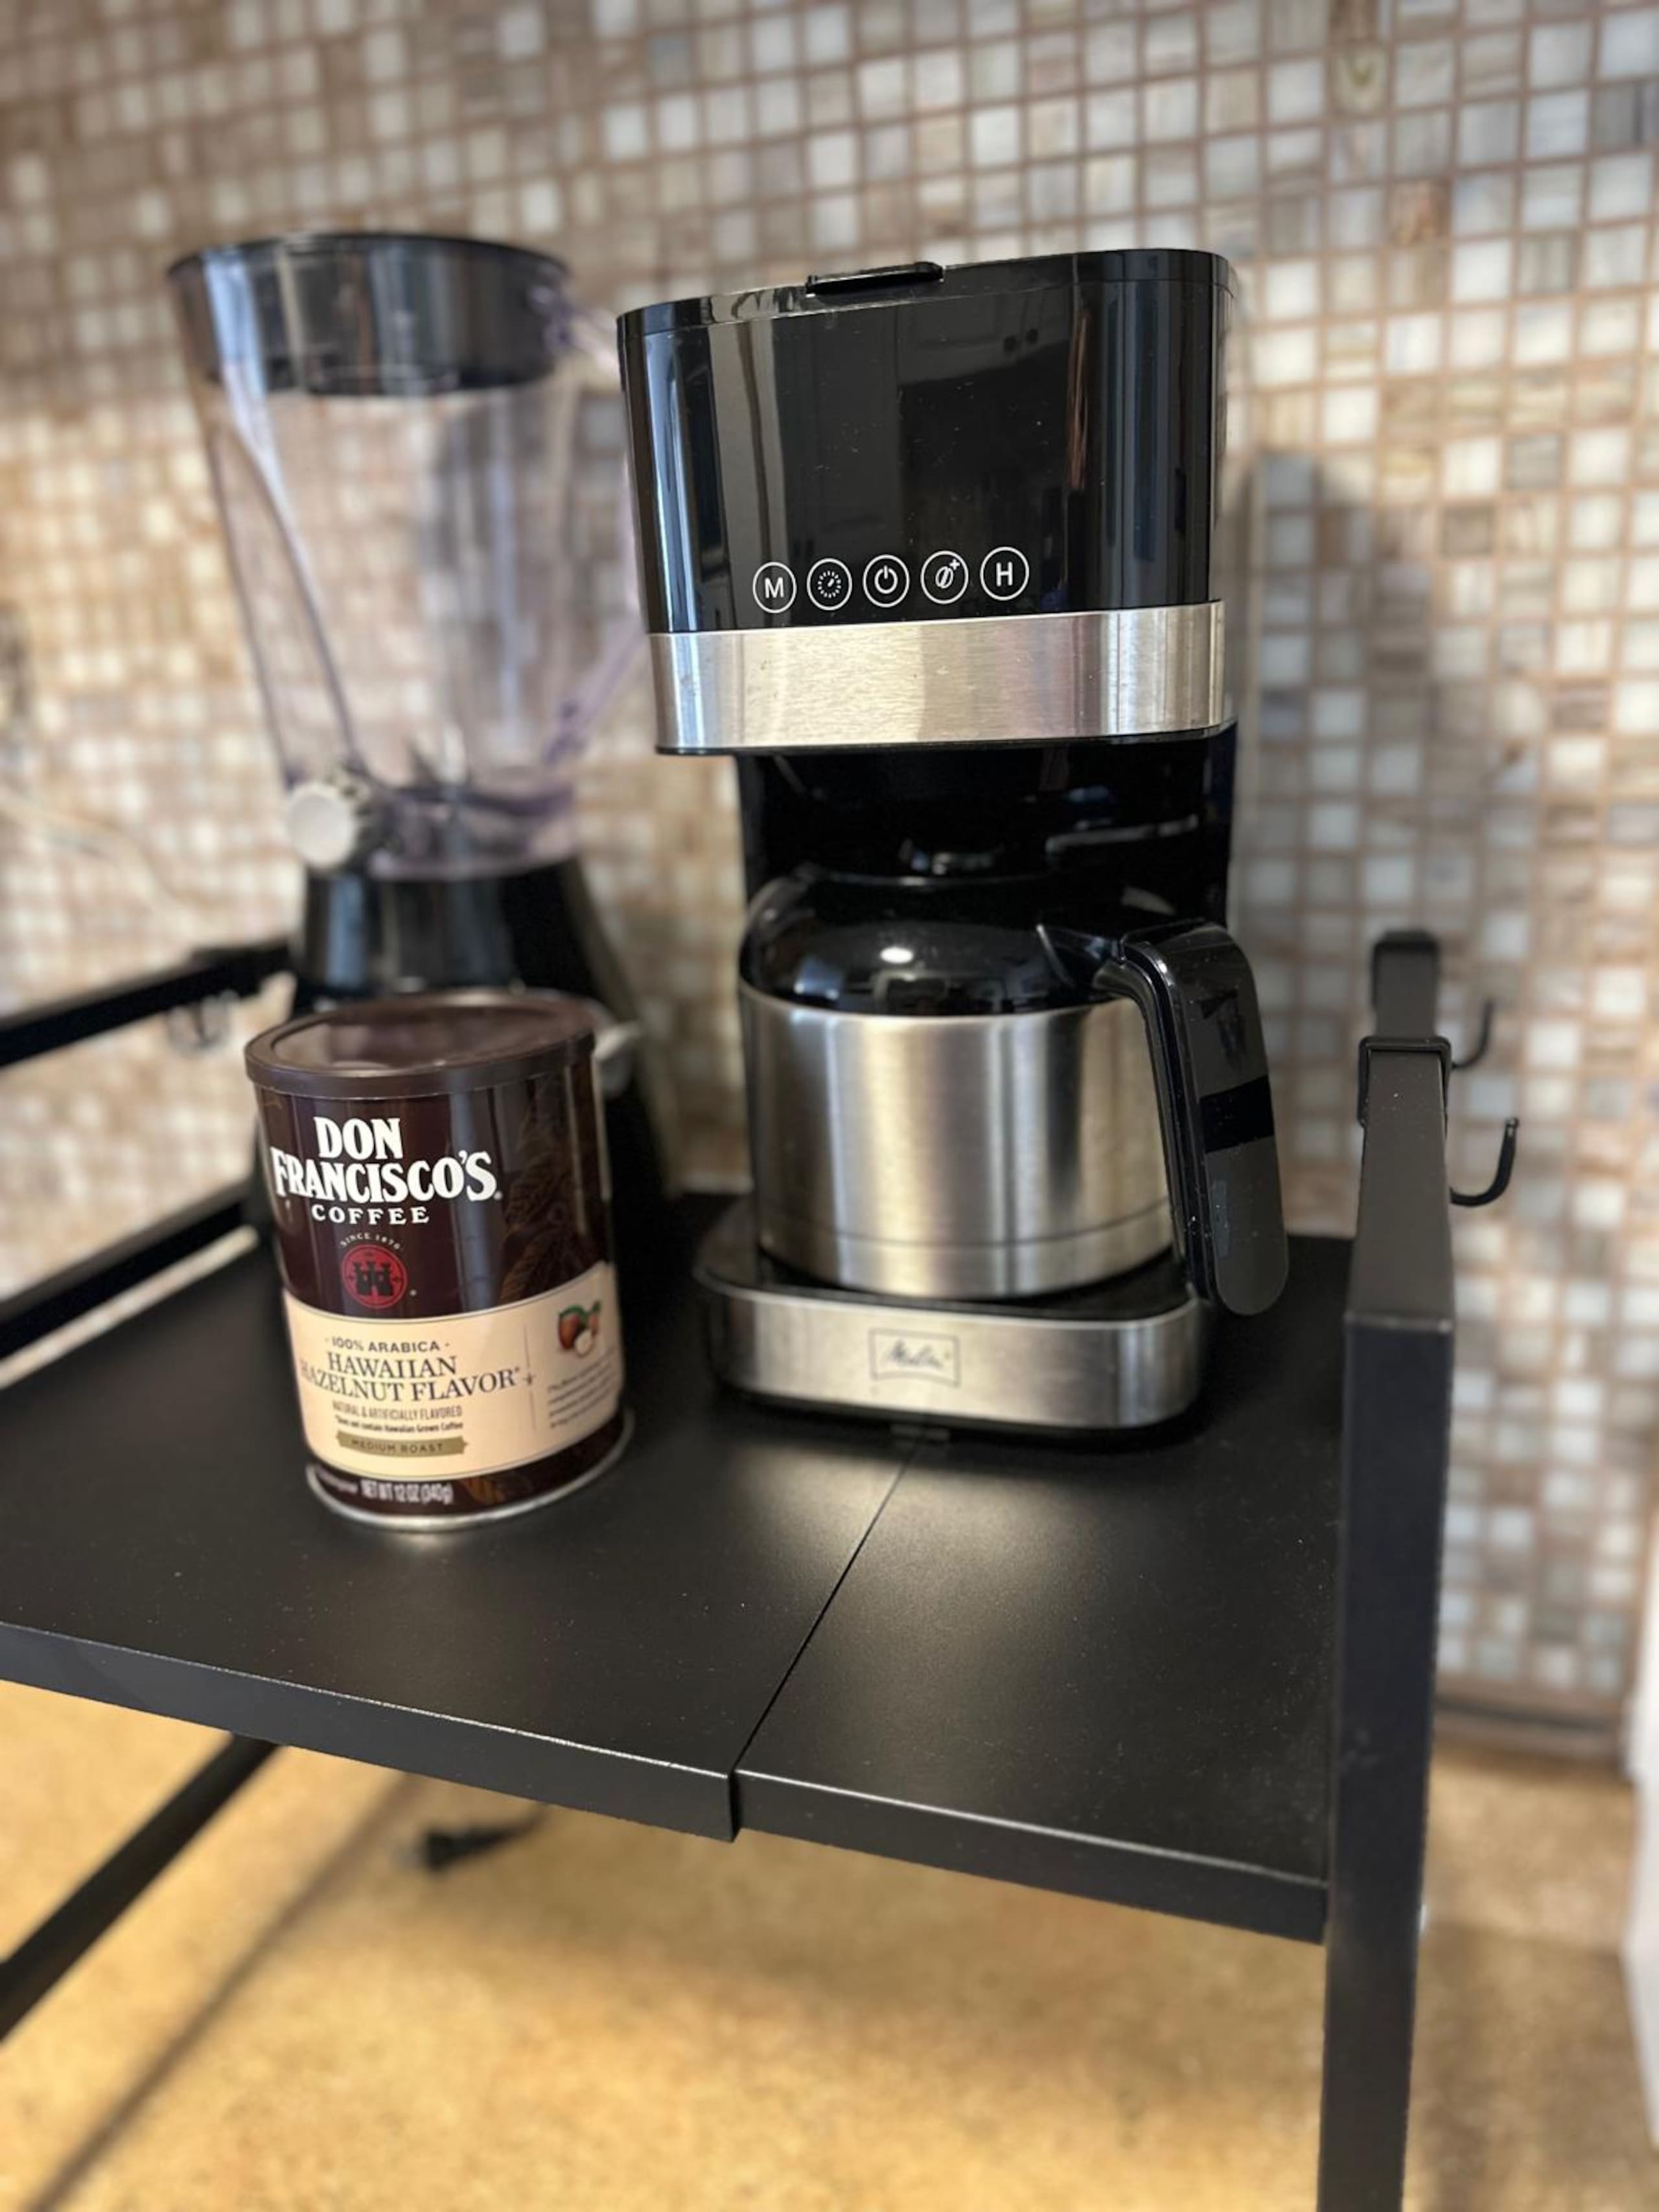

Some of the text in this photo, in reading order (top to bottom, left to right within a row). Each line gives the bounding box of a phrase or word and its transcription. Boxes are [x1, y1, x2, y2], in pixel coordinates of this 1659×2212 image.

[995, 561, 1014, 587] H
[764, 577, 785, 599] M
[313, 1116, 403, 1160] DON
[270, 1146, 498, 1204] FRANCISCO'S
[311, 1204, 430, 1225] COFFEE
[332, 1336, 441, 1353] 100% ARABICA
[327, 1351, 458, 1379] HAWAIIAN
[421, 1405, 463, 1420] FLAVORED
[352, 1438, 443, 1453] MEDIUM ROAST
